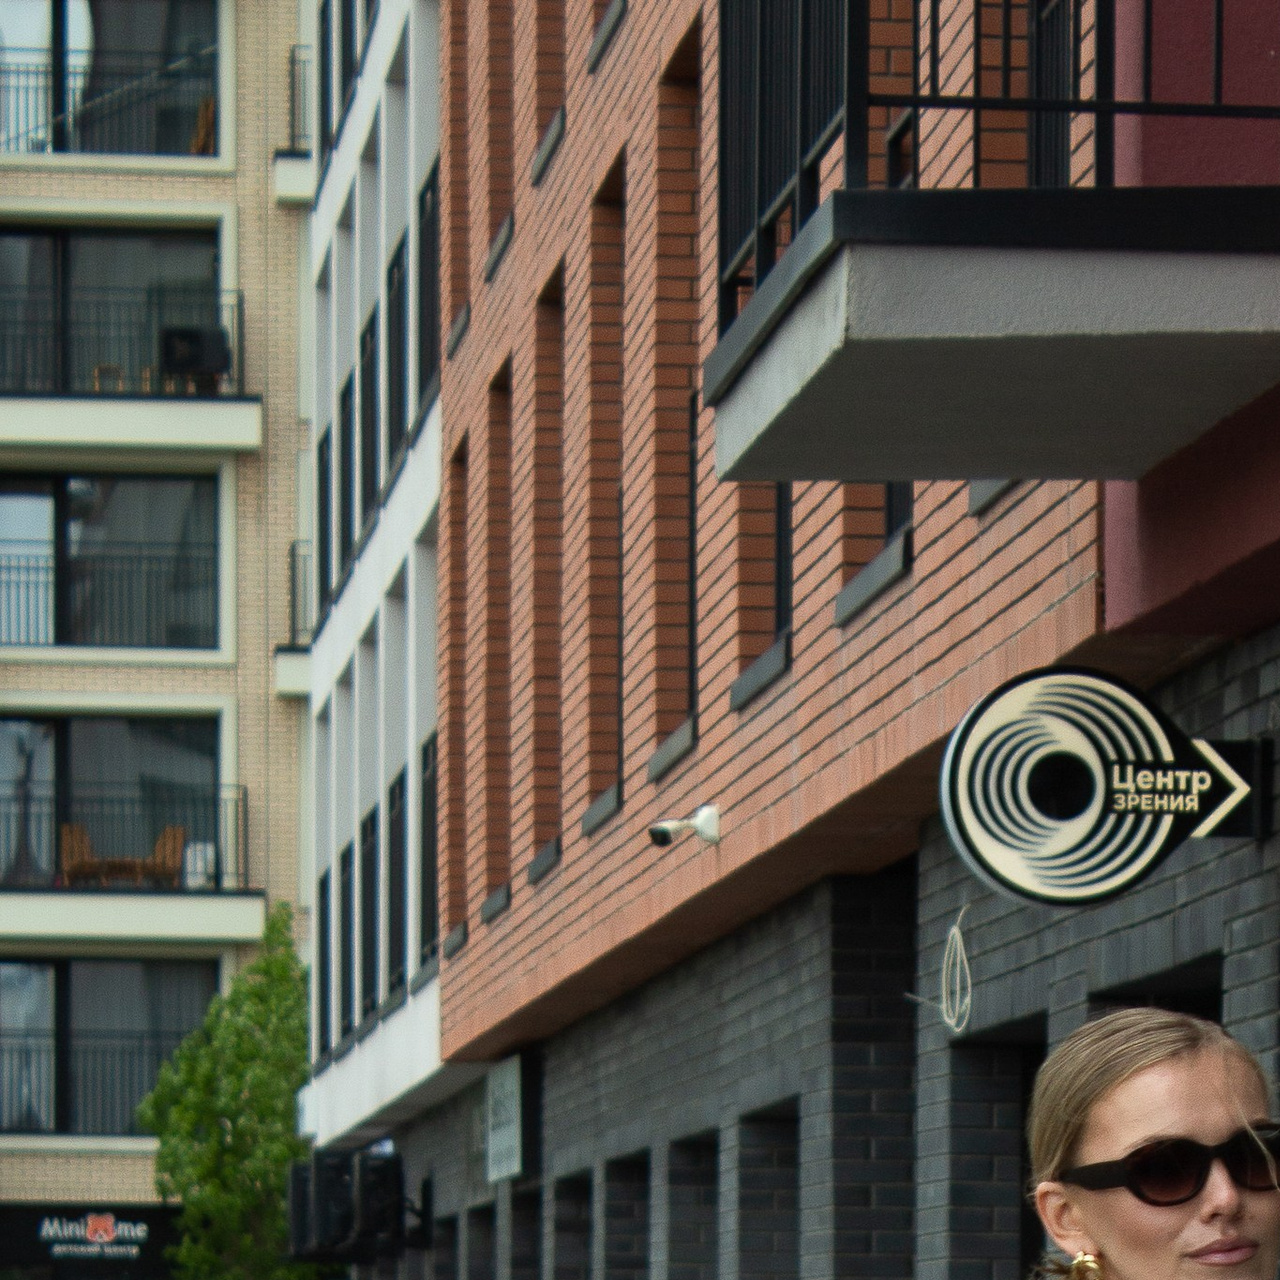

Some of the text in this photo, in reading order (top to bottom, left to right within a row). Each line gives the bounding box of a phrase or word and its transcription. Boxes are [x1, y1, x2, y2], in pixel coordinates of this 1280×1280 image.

[1112, 764, 1212, 795] Центр
[1112, 793, 1199, 811] ЗРЕНИЯ
[40, 1216, 149, 1239] Mini me
